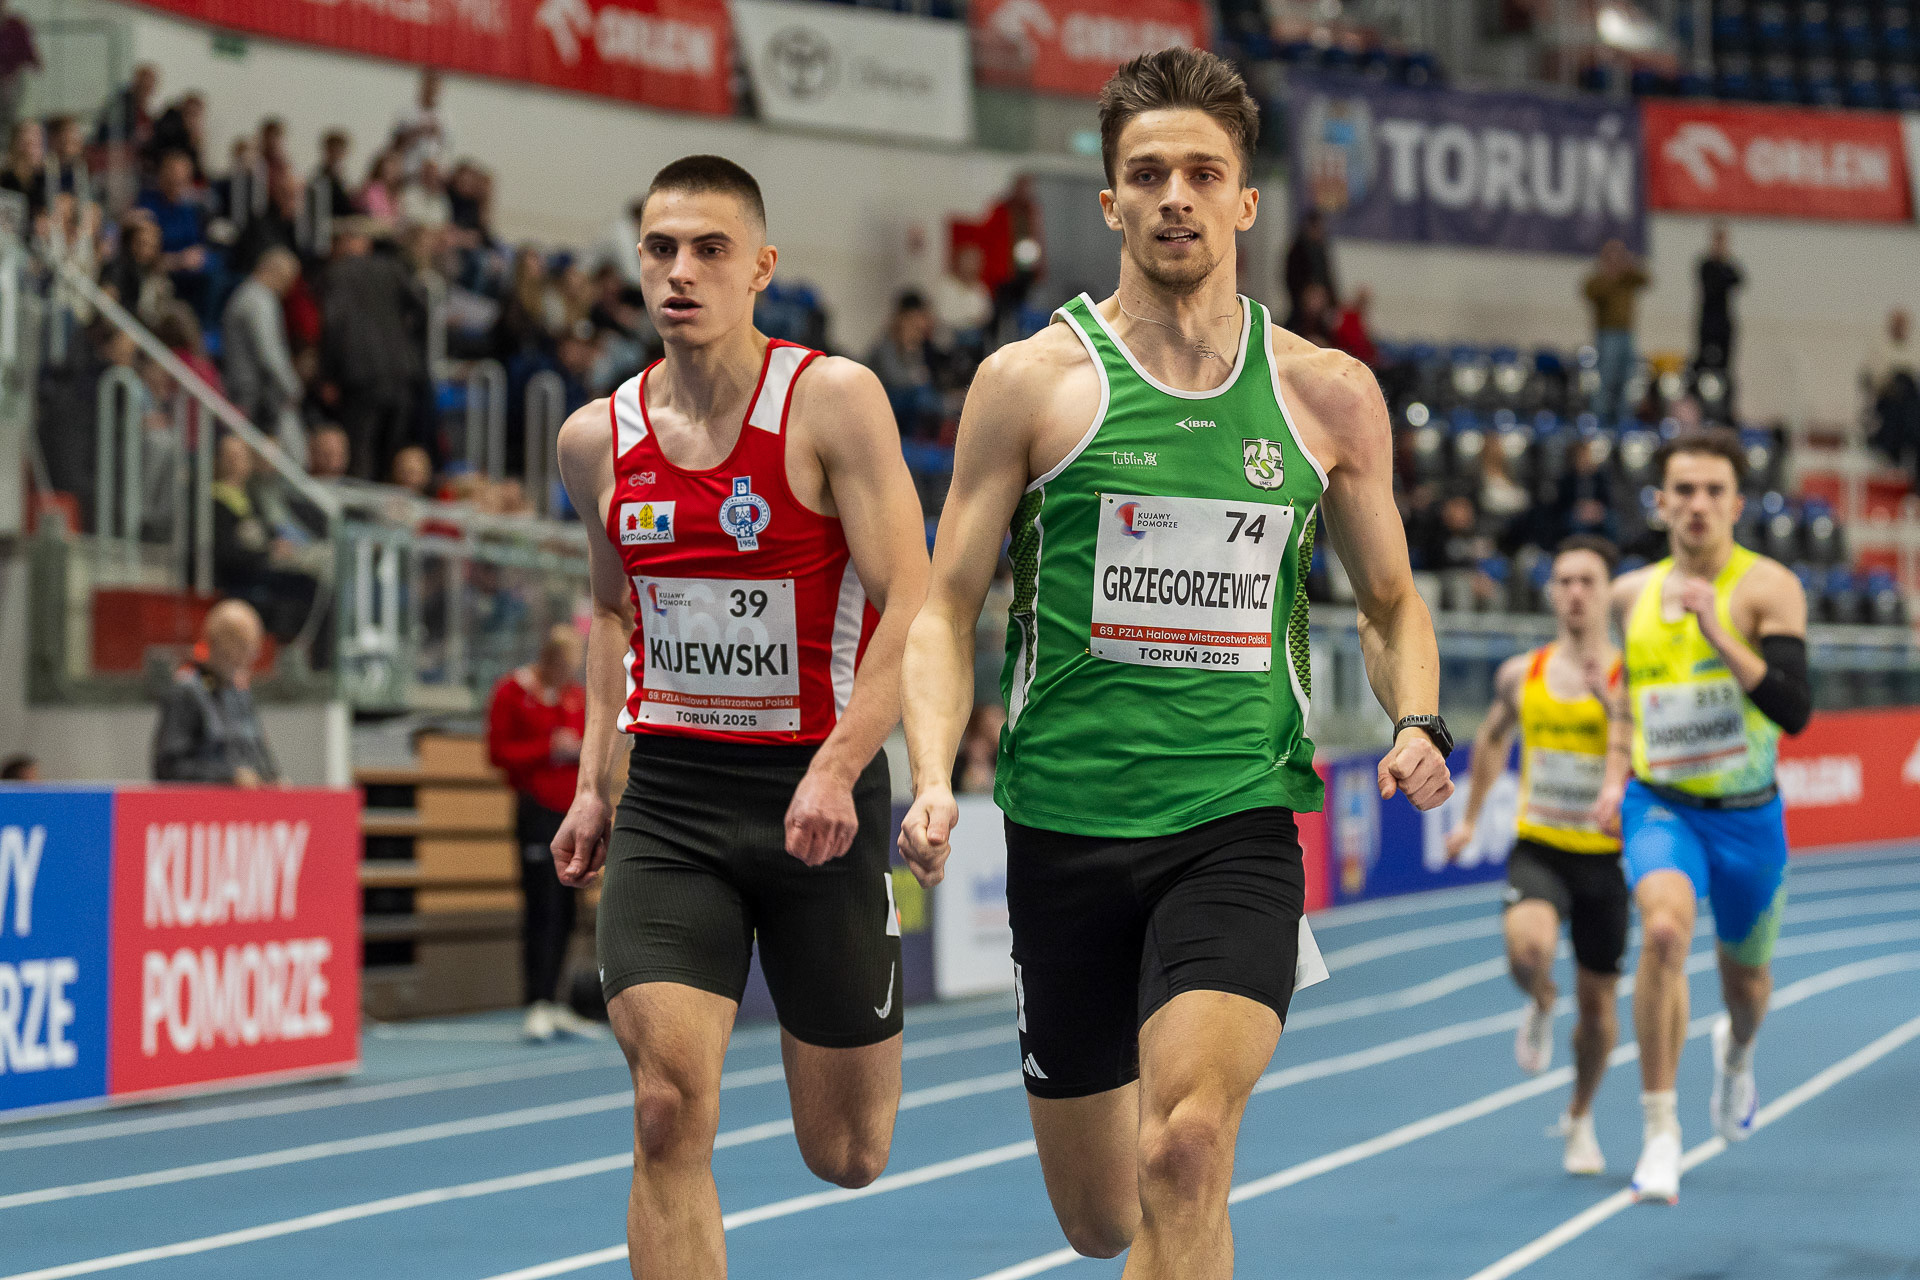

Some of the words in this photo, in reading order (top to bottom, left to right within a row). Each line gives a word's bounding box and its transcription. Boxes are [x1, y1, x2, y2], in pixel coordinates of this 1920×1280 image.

[1381, 113, 1635, 222] TORUŃ
[1743, 136, 1891, 192] ORLEN
[1137, 520, 1178, 528] POMORZE
[1138, 512, 1171, 520] KUJAWY
[1226, 510, 1267, 544] 74
[620, 531, 670, 542] BYDGOSZCZ
[739, 540, 757, 548] 1956
[659, 592, 685, 600] KUJAWY
[1103, 565, 1271, 610] GRZEGORZEWICZ
[659, 599, 692, 607] POMORZE
[729, 589, 768, 618] 39
[1099, 626, 1116, 636] 69.
[1118, 628, 1143, 638] PZLA
[1146, 630, 1186, 641] Halowe
[1189, 632, 1247, 644] Mistrzostwa
[1248, 635, 1267, 645] Polski
[650, 637, 789, 676] KIJEWSKI
[1138, 647, 1198, 663] TORUŃ
[1201, 651, 1240, 665] 2025
[648, 690, 661, 700] 69.
[661, 693, 680, 702] PZLA
[710, 698, 763, 708] Mistrzostwa
[765, 698, 794, 707] Polski
[676, 710, 720, 725] TORUŃ
[723, 714, 757, 726] 2025
[144, 820, 310, 930] KUJAWY
[142, 937, 331, 1057] POMORZE
